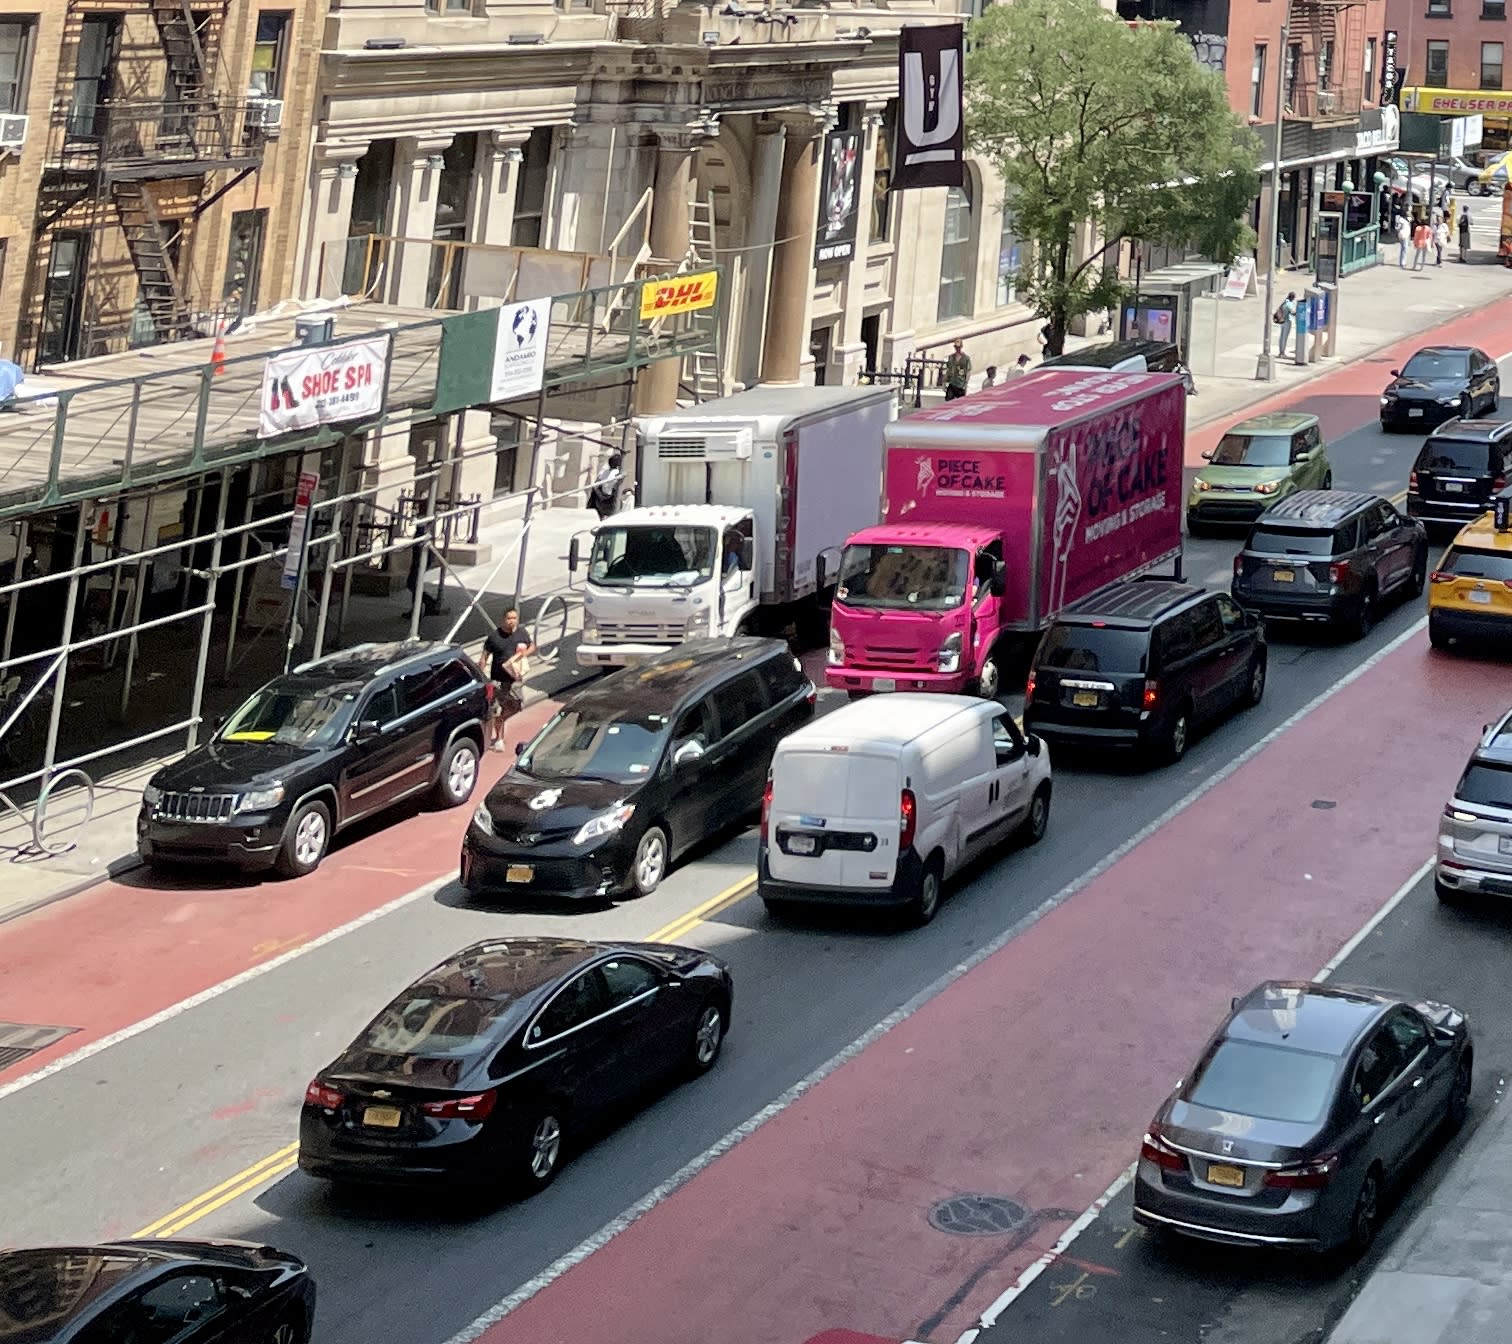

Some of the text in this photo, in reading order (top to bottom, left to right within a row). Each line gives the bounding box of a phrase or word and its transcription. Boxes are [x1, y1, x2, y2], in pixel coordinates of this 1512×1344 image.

[904, 48, 959, 147] U
[653, 281, 704, 310] DHL
[301, 363, 372, 400] SHOE SPA
[938, 459, 980, 474] PIECE
[961, 475, 1005, 491] CAKE
[1117, 447, 1168, 504] CAKE
